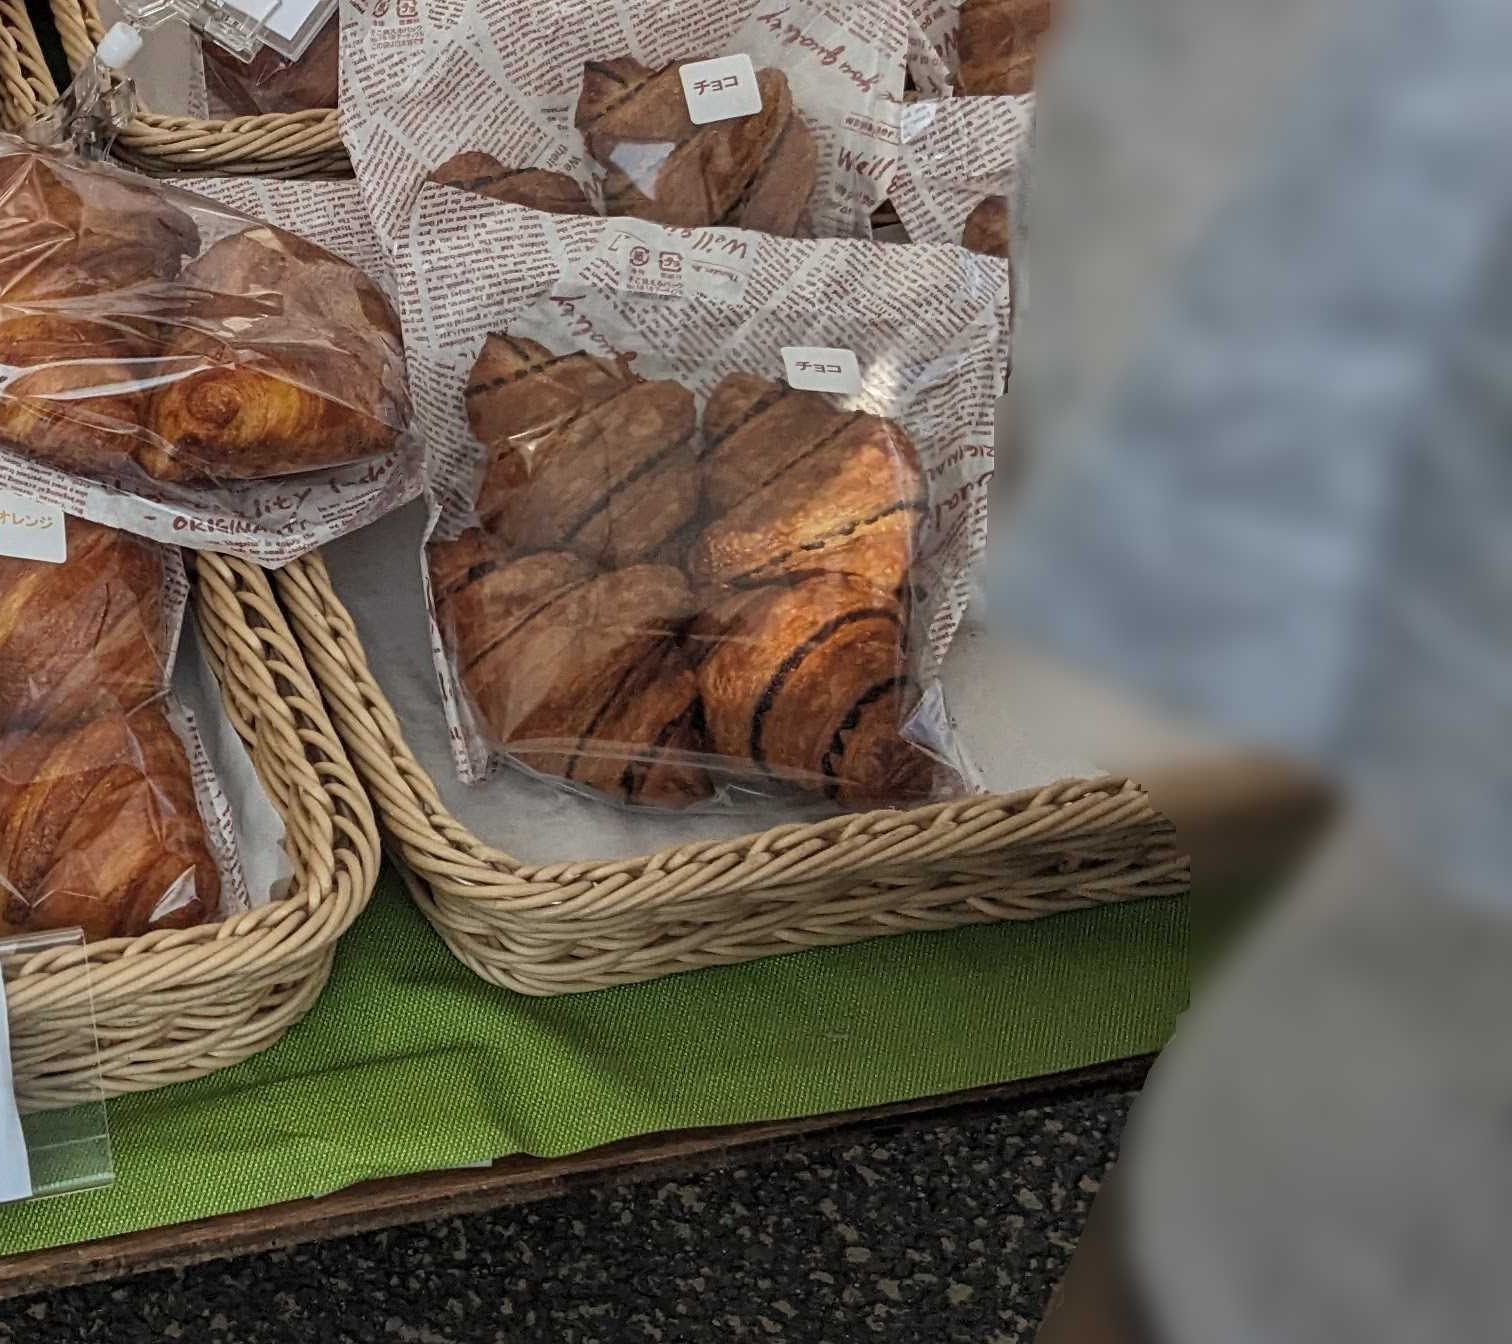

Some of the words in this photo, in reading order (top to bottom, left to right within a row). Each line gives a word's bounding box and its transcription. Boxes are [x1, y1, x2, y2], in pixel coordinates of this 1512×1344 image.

[693, 74, 738, 96] チョコ
[796, 360, 842, 374] チョコ
